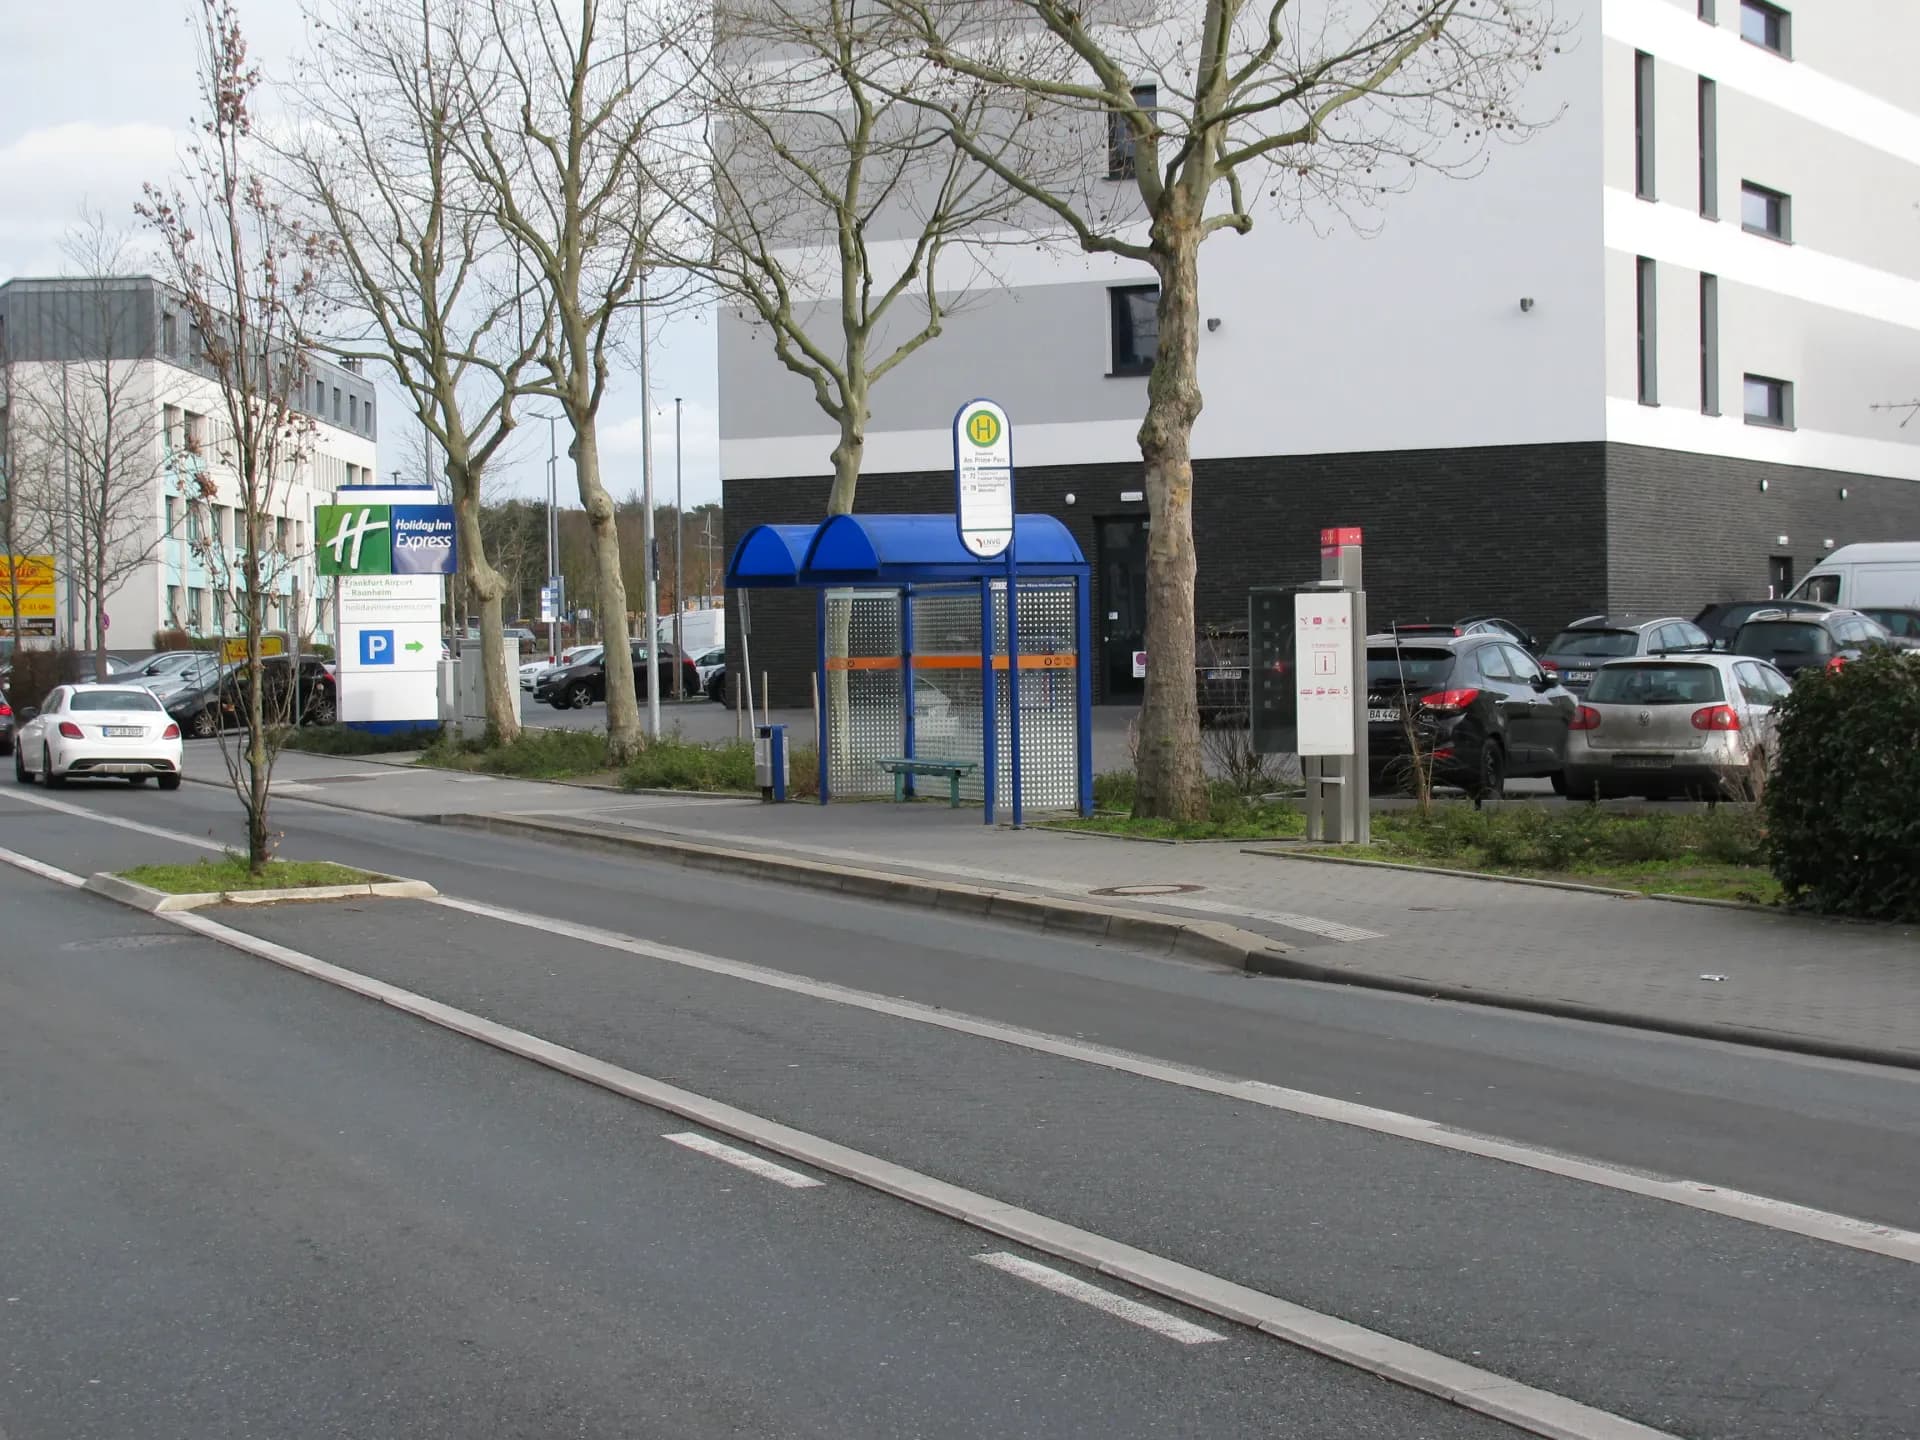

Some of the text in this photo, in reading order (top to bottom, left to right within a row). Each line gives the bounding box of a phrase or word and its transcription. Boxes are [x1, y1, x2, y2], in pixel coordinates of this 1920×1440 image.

[976, 419, 991, 440] H
[396, 518, 452, 533] Holiday Inn
[396, 532, 452, 552] Express
[345, 578, 413, 587] Frankfurt Airport
[351, 589, 392, 597] Raunheim
[368, 635, 387, 659] P
